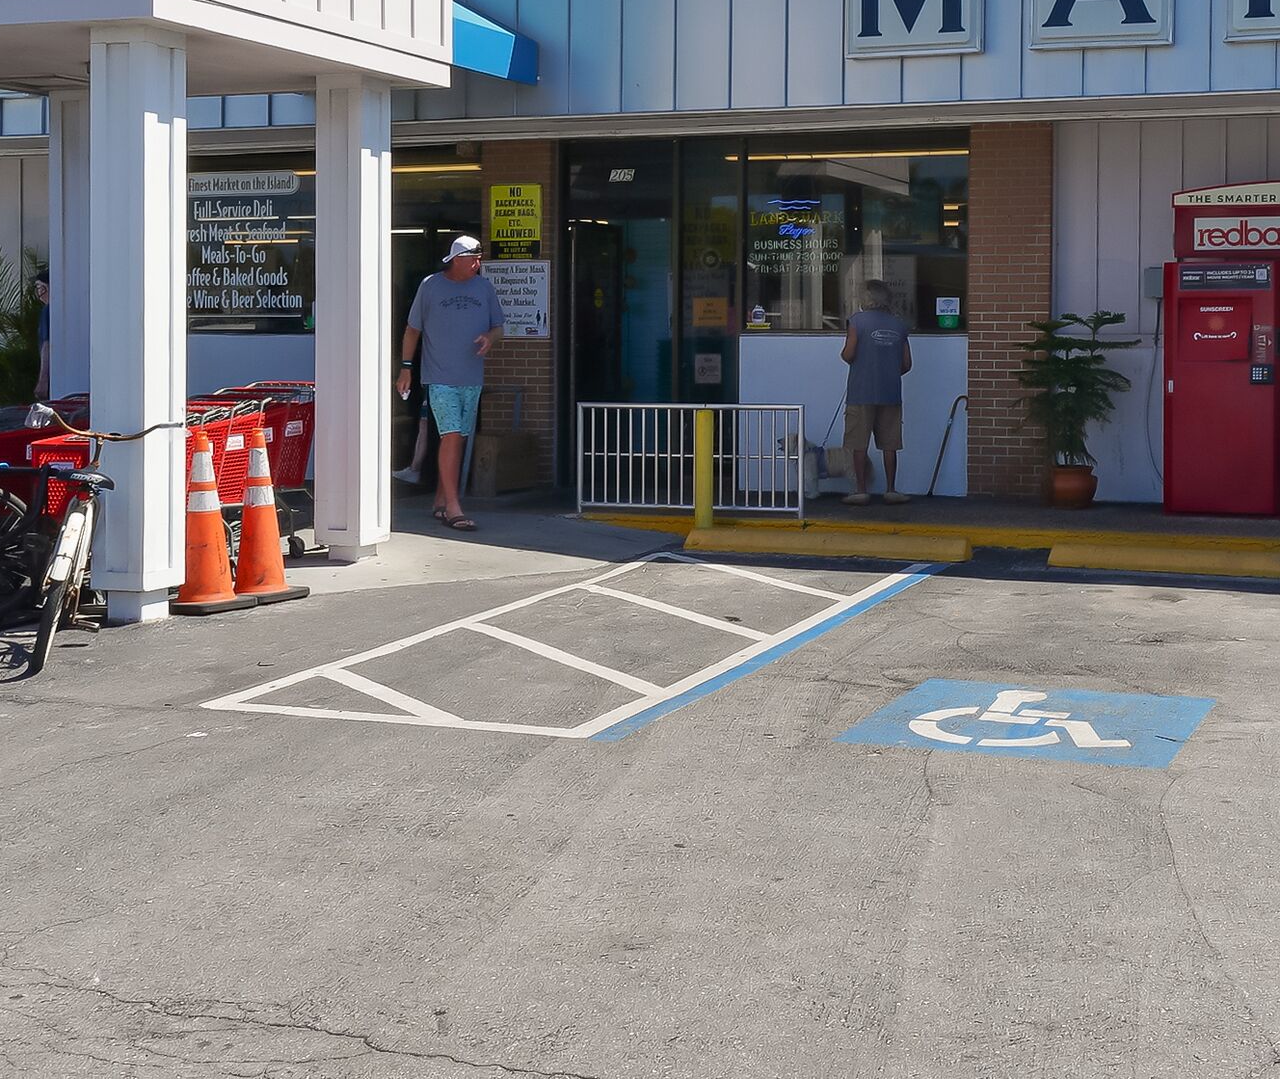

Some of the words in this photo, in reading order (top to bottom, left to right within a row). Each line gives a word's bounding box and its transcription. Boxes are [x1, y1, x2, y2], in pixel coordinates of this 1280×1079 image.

[610, 168, 634, 182] 205
[188, 177, 211, 192] Finest
[213, 177, 240, 191] Market
[241, 180, 251, 190] on
[252, 176, 266, 190] the
[267, 175, 294, 190] Island!
[509, 187, 522, 197] NO
[1187, 194, 1211, 204] THE
[1217, 193, 1277, 204] SMARTER
[193, 200, 252, 219] Full-Service
[253, 199, 273, 217] Deli
[495, 208, 516, 217] BEACH
[508, 219, 523, 227] ETC.
[187, 223, 207, 242] resh
[209, 223, 233, 242] Meat
[235, 222, 243, 241] &
[245, 221, 286, 239] Seafood
[495, 228, 536, 238] ALLOWED!
[754, 239, 802, 250] BUSINESS
[805, 239, 838, 249] HOURS
[202, 244, 266, 265] Meals-To-Go
[484, 265, 509, 274] Wearing
[514, 266, 528, 274] Face
[529, 265, 545, 274] Mask
[187, 267, 211, 287] offee
[212, 267, 221, 286] &
[223, 267, 254, 286] Baked
[256, 266, 288, 286] Goods
[494, 276, 500, 284] Is
[501, 276, 528, 286] Required
[528, 276, 536, 284] To
[496, 287, 509, 295] nter
[510, 287, 521, 295] And
[522, 287, 538, 296] Shop
[193, 289, 219, 308] Wine
[221, 289, 230, 309] &
[232, 290, 255, 308] Beer
[256, 289, 303, 308] Selection
